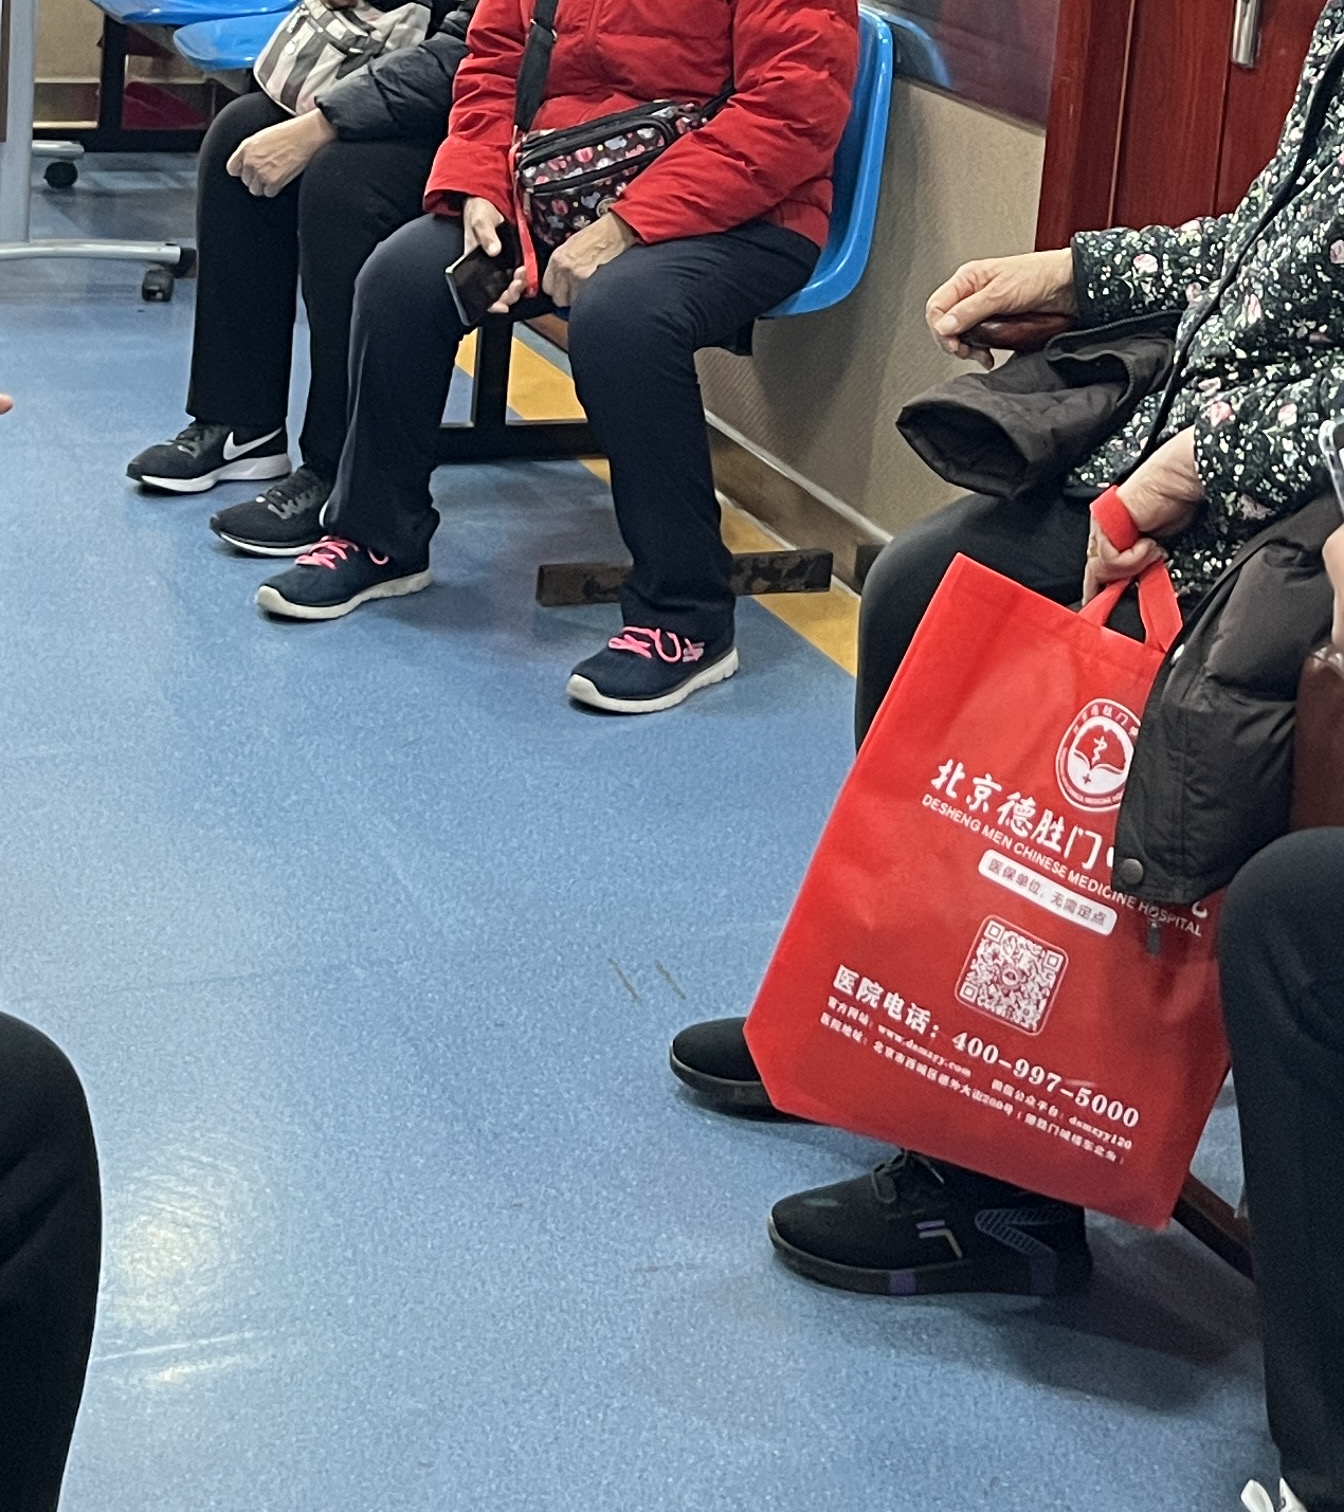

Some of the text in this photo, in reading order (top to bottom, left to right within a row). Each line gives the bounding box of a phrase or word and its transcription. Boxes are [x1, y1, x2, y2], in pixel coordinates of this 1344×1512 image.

[922, 793, 980, 832] DESHENG
[981, 824, 1014, 850] MEN
[1013, 841, 1068, 879] CHINESE
[1067, 869, 1137, 910] MEDICINE
[1138, 900, 1202, 937] HOSPITAL
